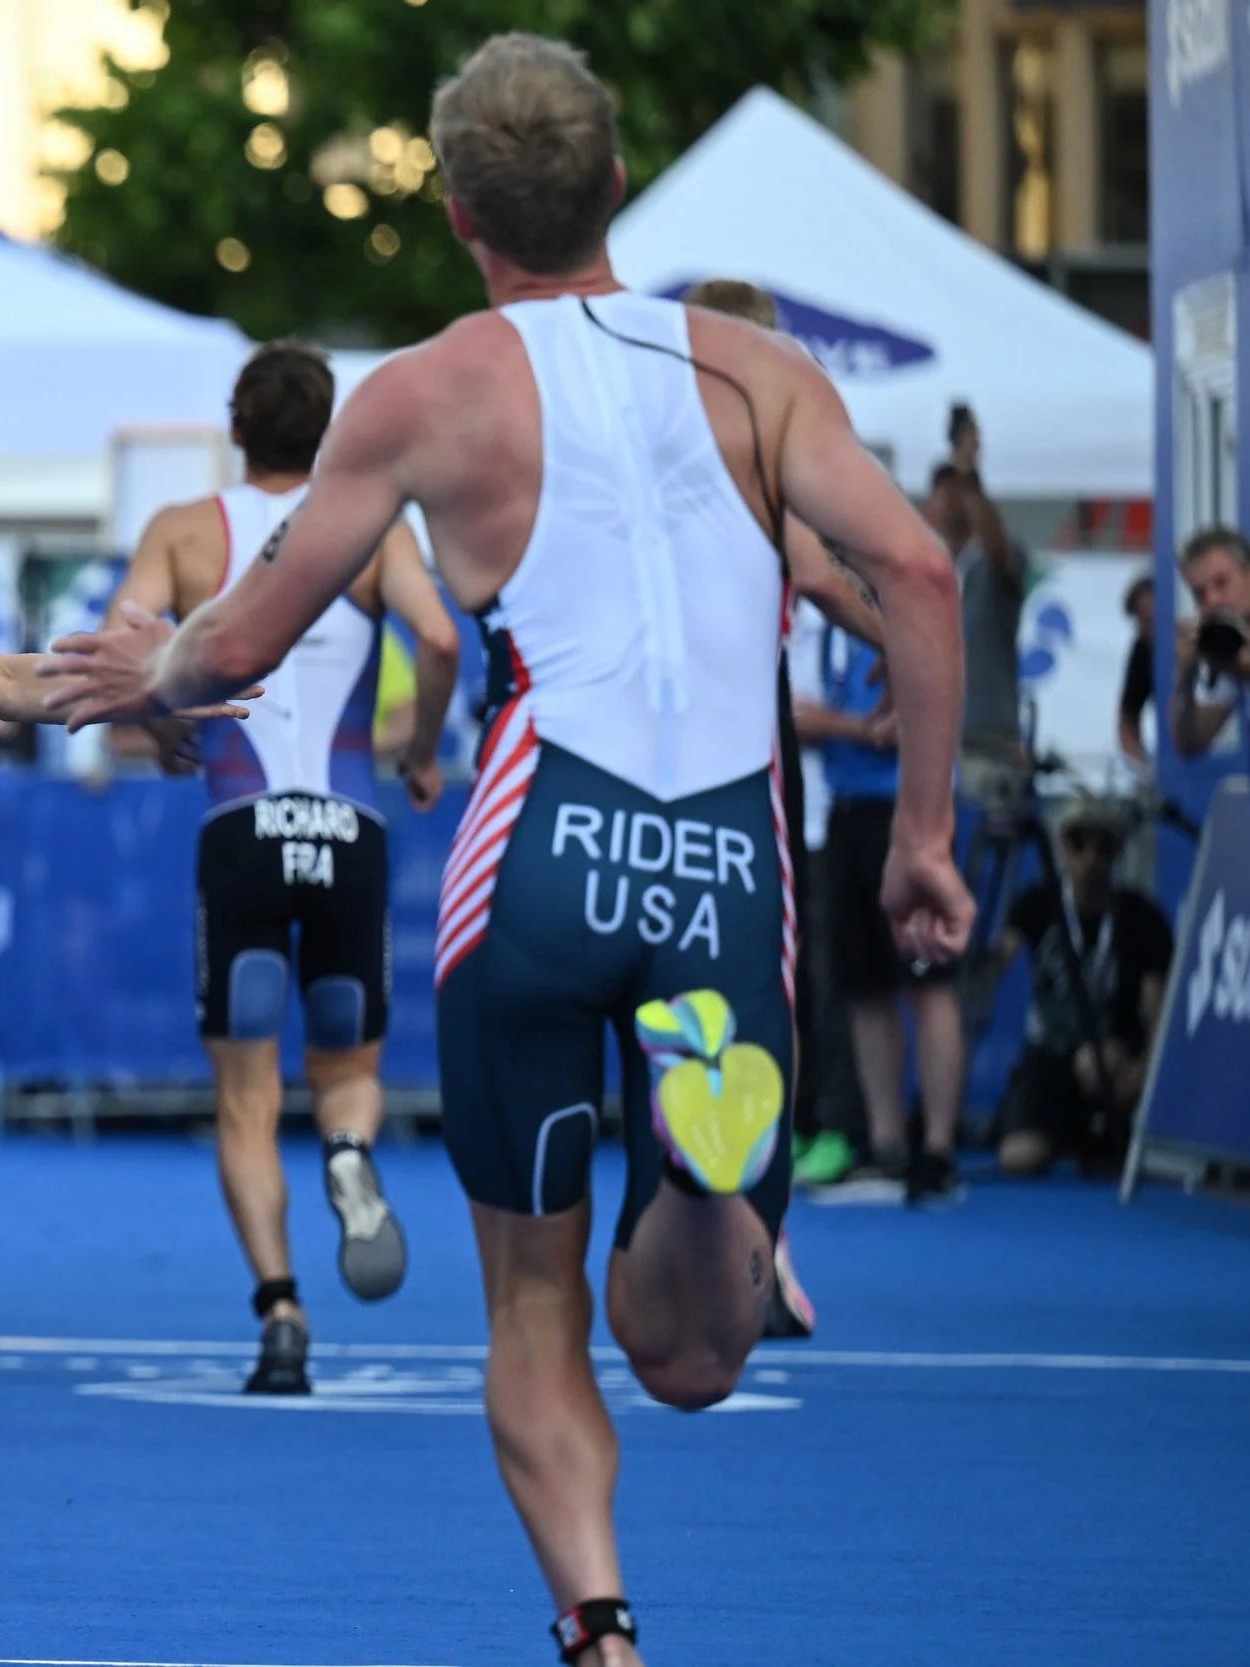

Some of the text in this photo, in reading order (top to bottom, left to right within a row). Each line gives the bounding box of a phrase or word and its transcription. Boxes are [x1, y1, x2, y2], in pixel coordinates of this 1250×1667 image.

[254, 796, 359, 844] RICHARD
[552, 803, 756, 894] RIDER
[282, 841, 334, 889] FRA
[584, 868, 720, 960] USA
